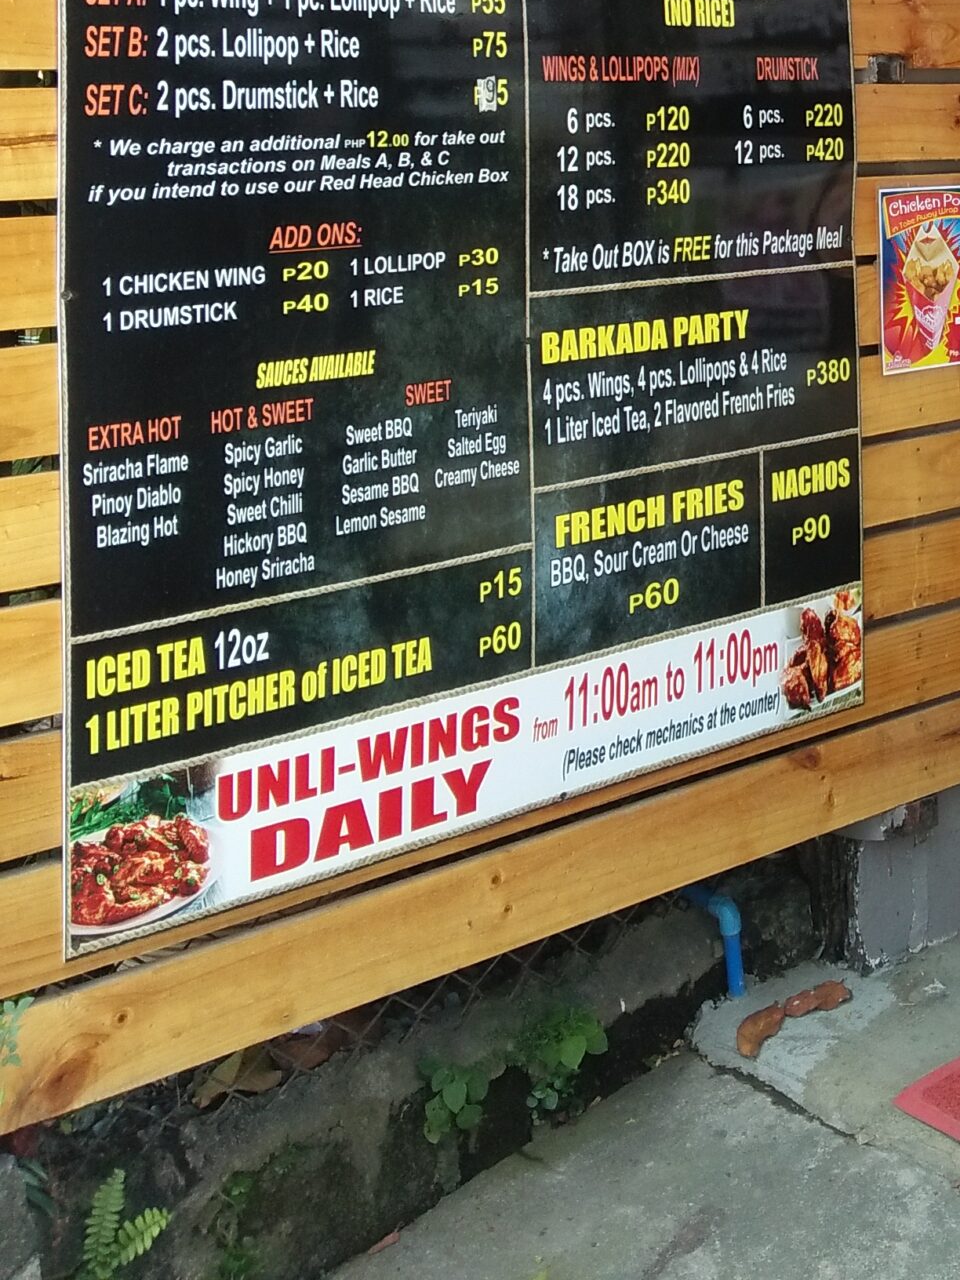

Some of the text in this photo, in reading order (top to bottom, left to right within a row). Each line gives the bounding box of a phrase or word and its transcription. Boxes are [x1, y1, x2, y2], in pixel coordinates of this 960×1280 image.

[542, 56, 700, 87] WINGS & LOLLIPOPS (MIX)
[757, 57, 819, 81] DRUMSTICK
[567, 106, 689, 133] 6 pcs. P120
[110, 139, 142, 156] We
[147, 139, 215, 158] charge
[220, 138, 244, 154] an
[249, 134, 340, 152] additional
[414, 131, 437, 146] for
[442, 130, 474, 145] take
[479, 130, 505, 144] out
[734, 138, 844, 164] 12 pcs. P420
[167, 154, 371, 177] transactions on Meals
[889, 197, 940, 217] Chicken
[269, 223, 362, 250] ADD ONS:
[363, 249, 499, 275] LOLLIPOP P30
[119, 261, 329, 296] CHICKEN WING P20
[541, 309, 749, 364] BARKADA PARTY
[256, 351, 376, 389] SAUCES AVAILABLE
[556, 349, 787, 409] pcs. Wings, pcs. Lollipops Rice
[405, 380, 451, 406] SWEET
[556, 357, 850, 443] Liter Iced Tea, Flavored French Fries P380
[346, 417, 412, 446] Sweet BBQ
[455, 406, 497, 429] Teriyaki
[88, 417, 181, 451] EXTRA HOT
[447, 433, 506, 458] Salted Egg
[225, 435, 303, 465] Spicy Garlic
[83, 452, 189, 486] Sriracha Flame
[435, 459, 519, 489] Creamy Cheese
[772, 458, 850, 502] NACHOS
[92, 486, 181, 521] Pinoy Diablo
[555, 479, 744, 548] FRENCH FRIES
[97, 516, 178, 548] Blazing Hot
[792, 515, 830, 545] P90
[86, 567, 522, 699] ICED TEA 12oz P15
[532, 629, 778, 743] from 11:00am to 11:00pm
[563, 687, 780, 780] (Please check mechanics at the counter)
[217, 696, 520, 821] UNLI-WINGS
[250, 759, 492, 882] DAILY
